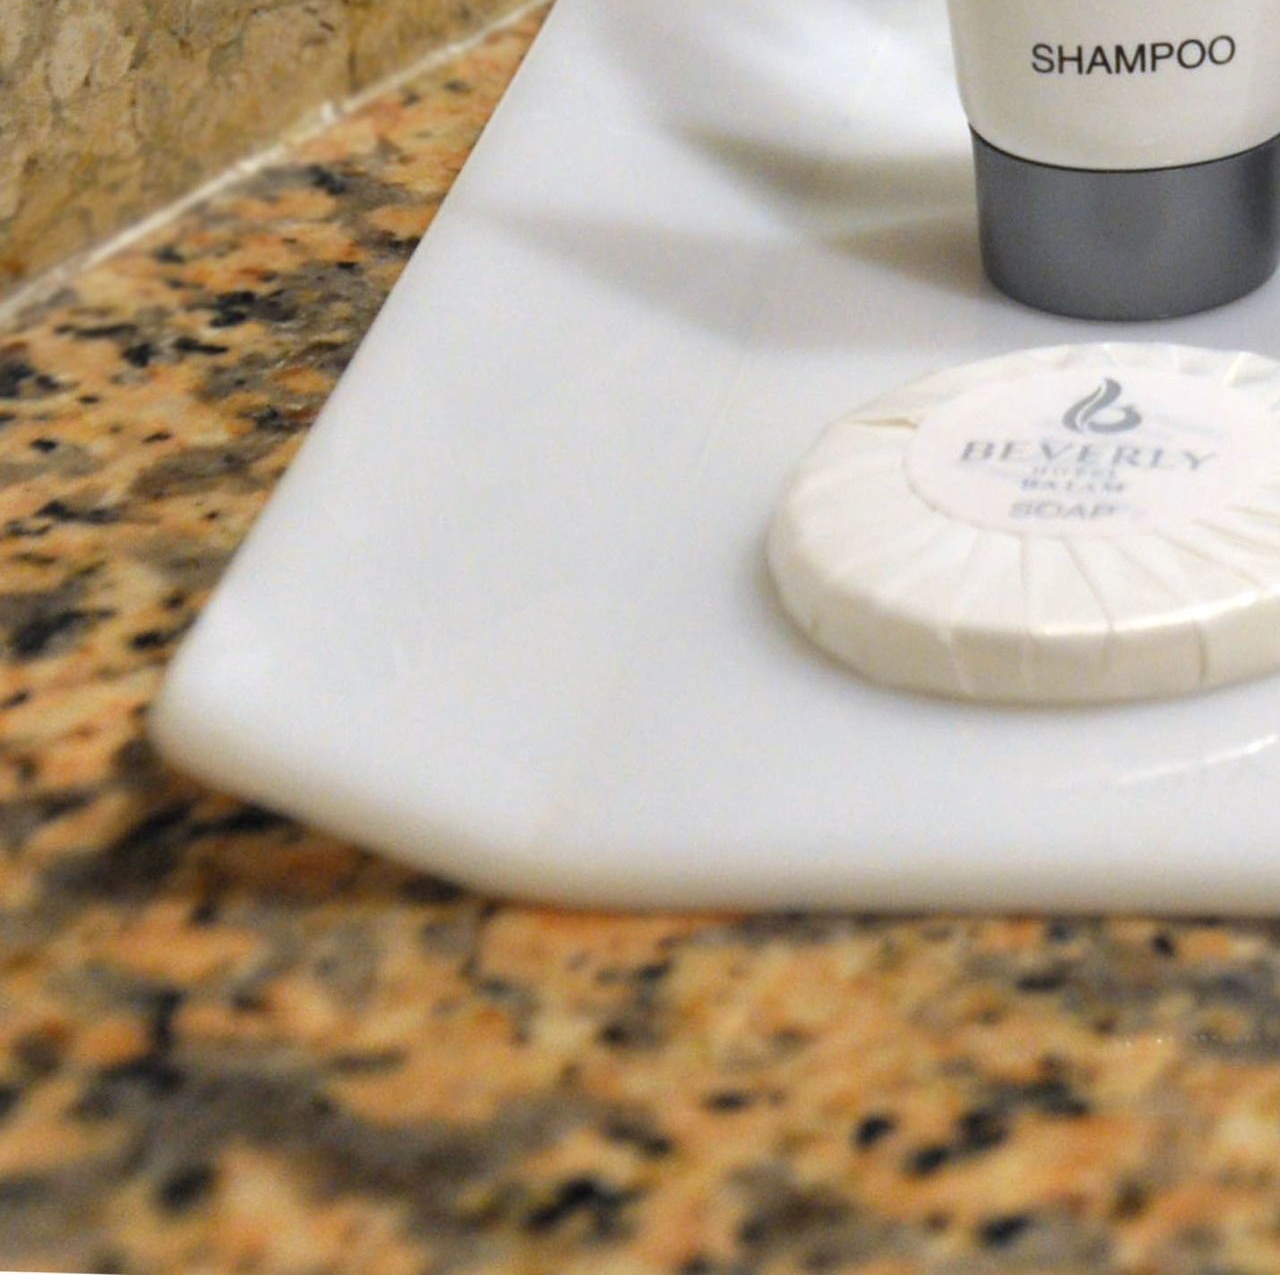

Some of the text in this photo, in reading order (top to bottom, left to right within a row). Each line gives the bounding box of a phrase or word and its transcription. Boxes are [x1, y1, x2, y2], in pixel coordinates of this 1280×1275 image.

[1031, 35, 1237, 75] SHAMPOO
[959, 440, 1217, 473] BEVERLY
[1008, 499, 1117, 520] SOAP
